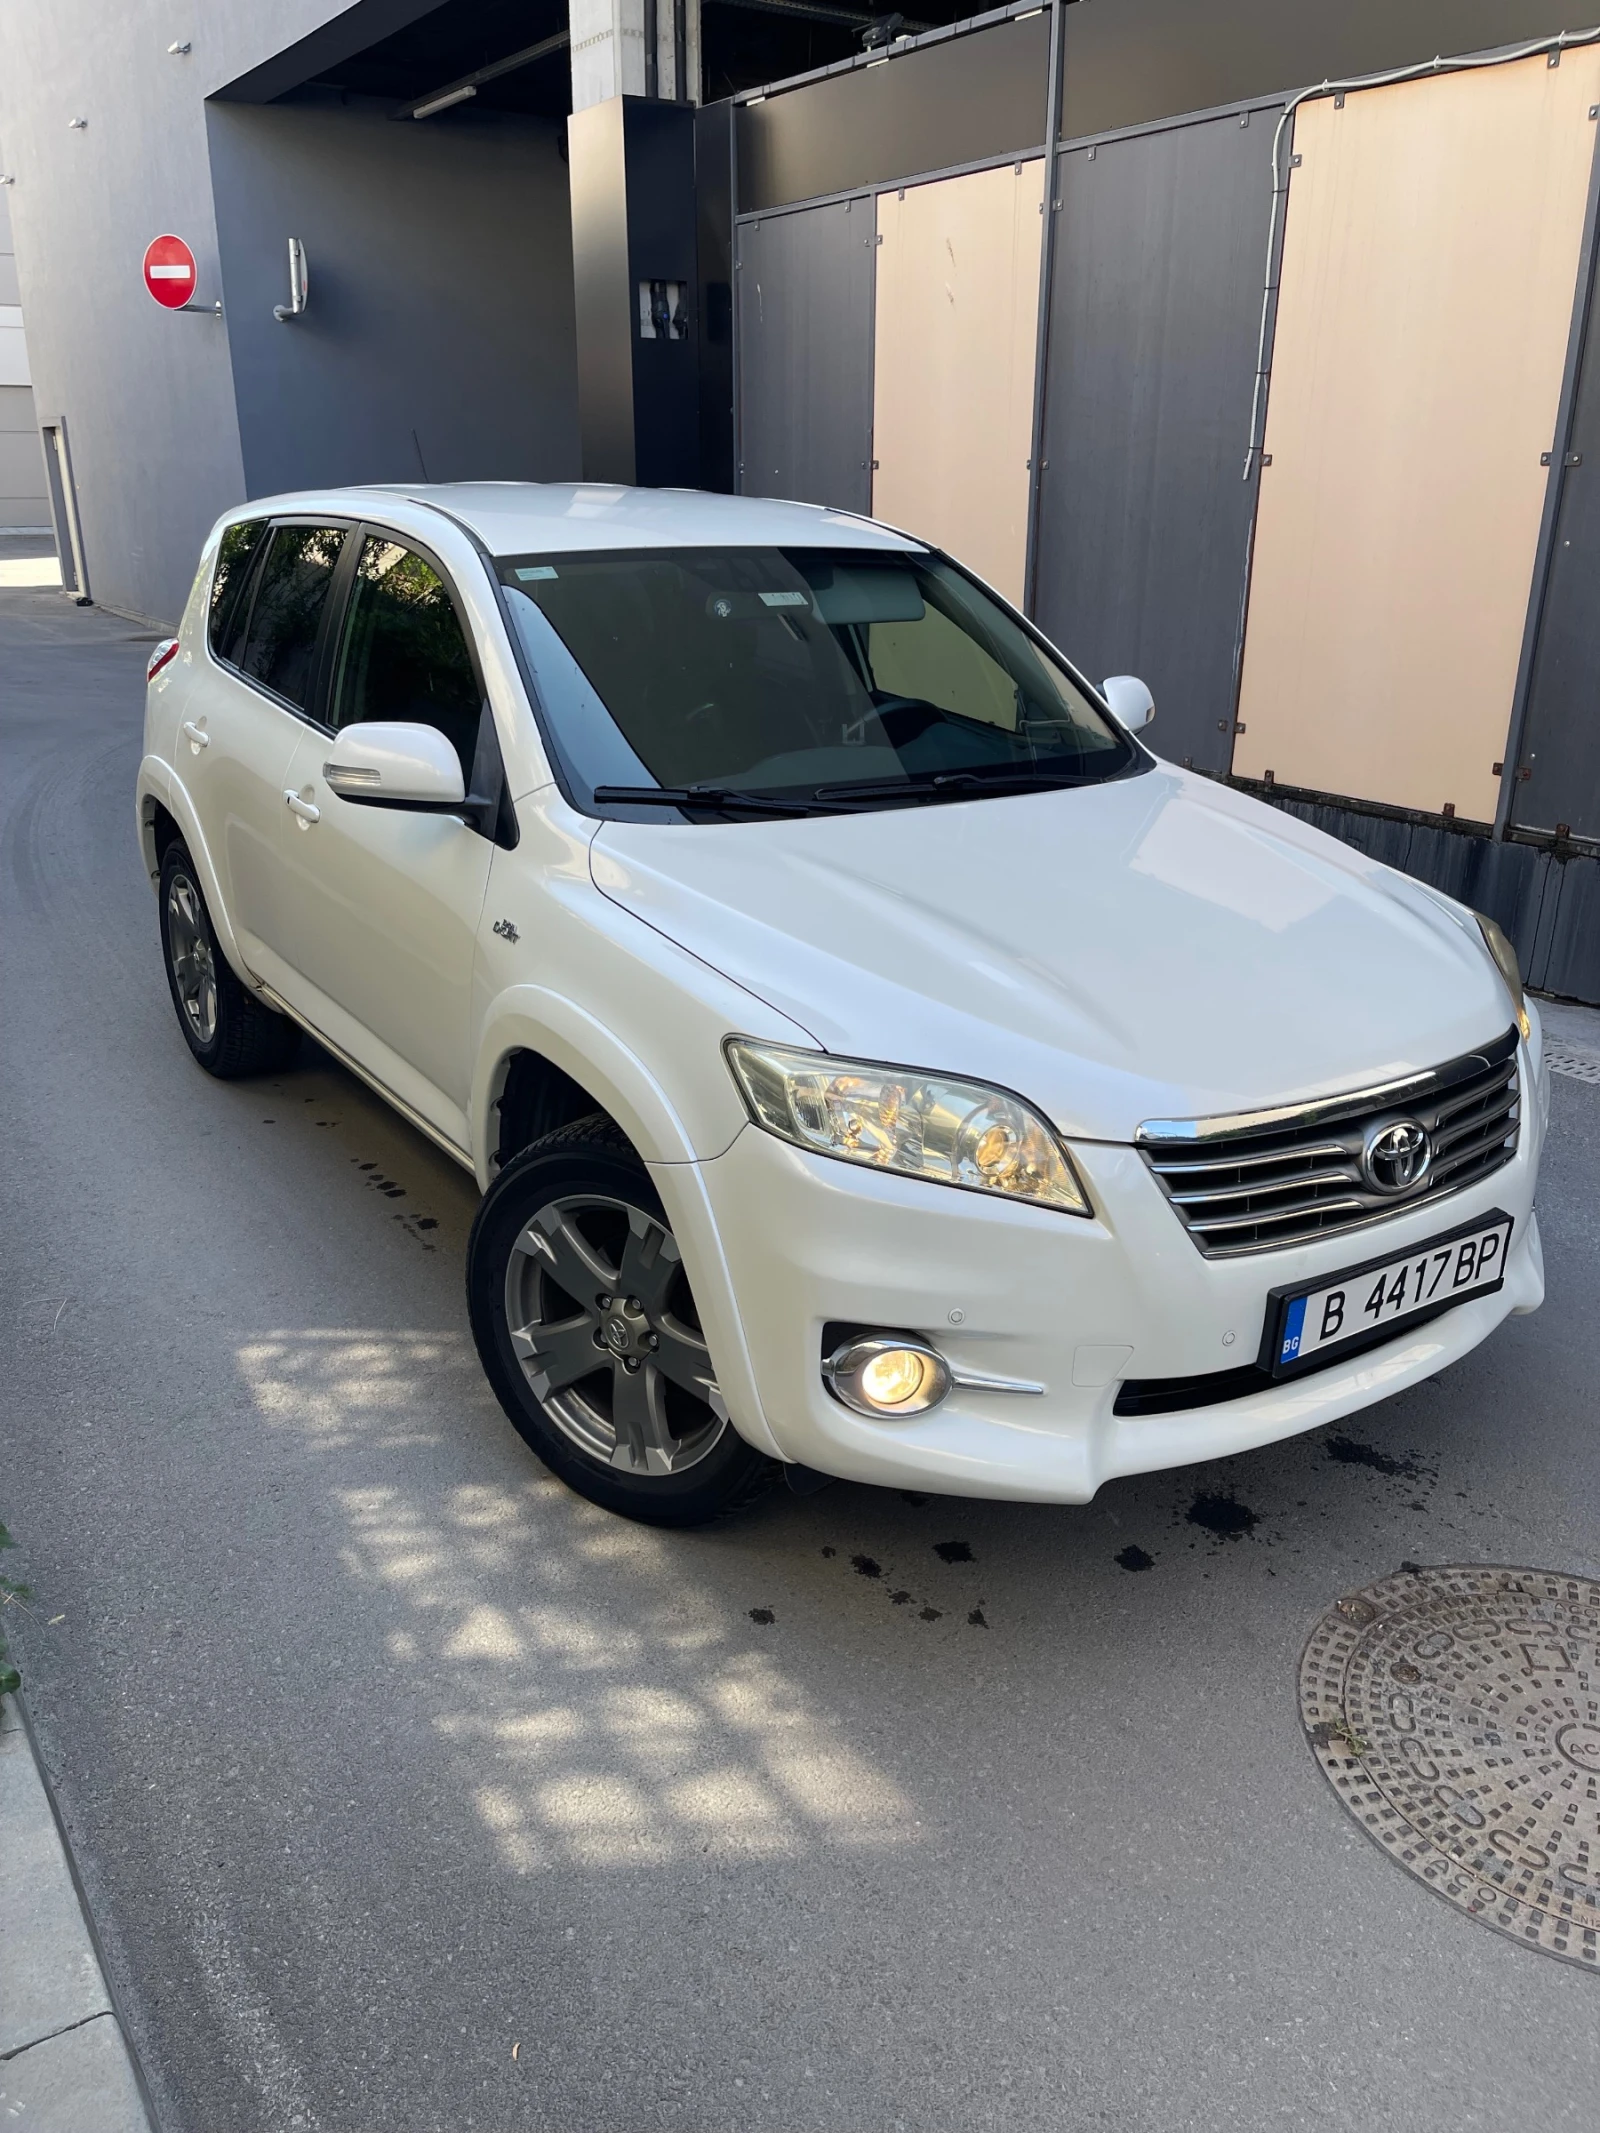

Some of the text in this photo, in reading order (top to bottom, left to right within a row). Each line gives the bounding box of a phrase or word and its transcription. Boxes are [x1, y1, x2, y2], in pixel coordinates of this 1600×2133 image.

[1320, 1290, 1345, 1341] B
[1282, 1336, 1299, 1355] BG
[1555, 1602, 1598, 1618] ACO
[1570, 1743, 1600, 1756] AC
[1429, 1859, 1497, 1903] ACO
